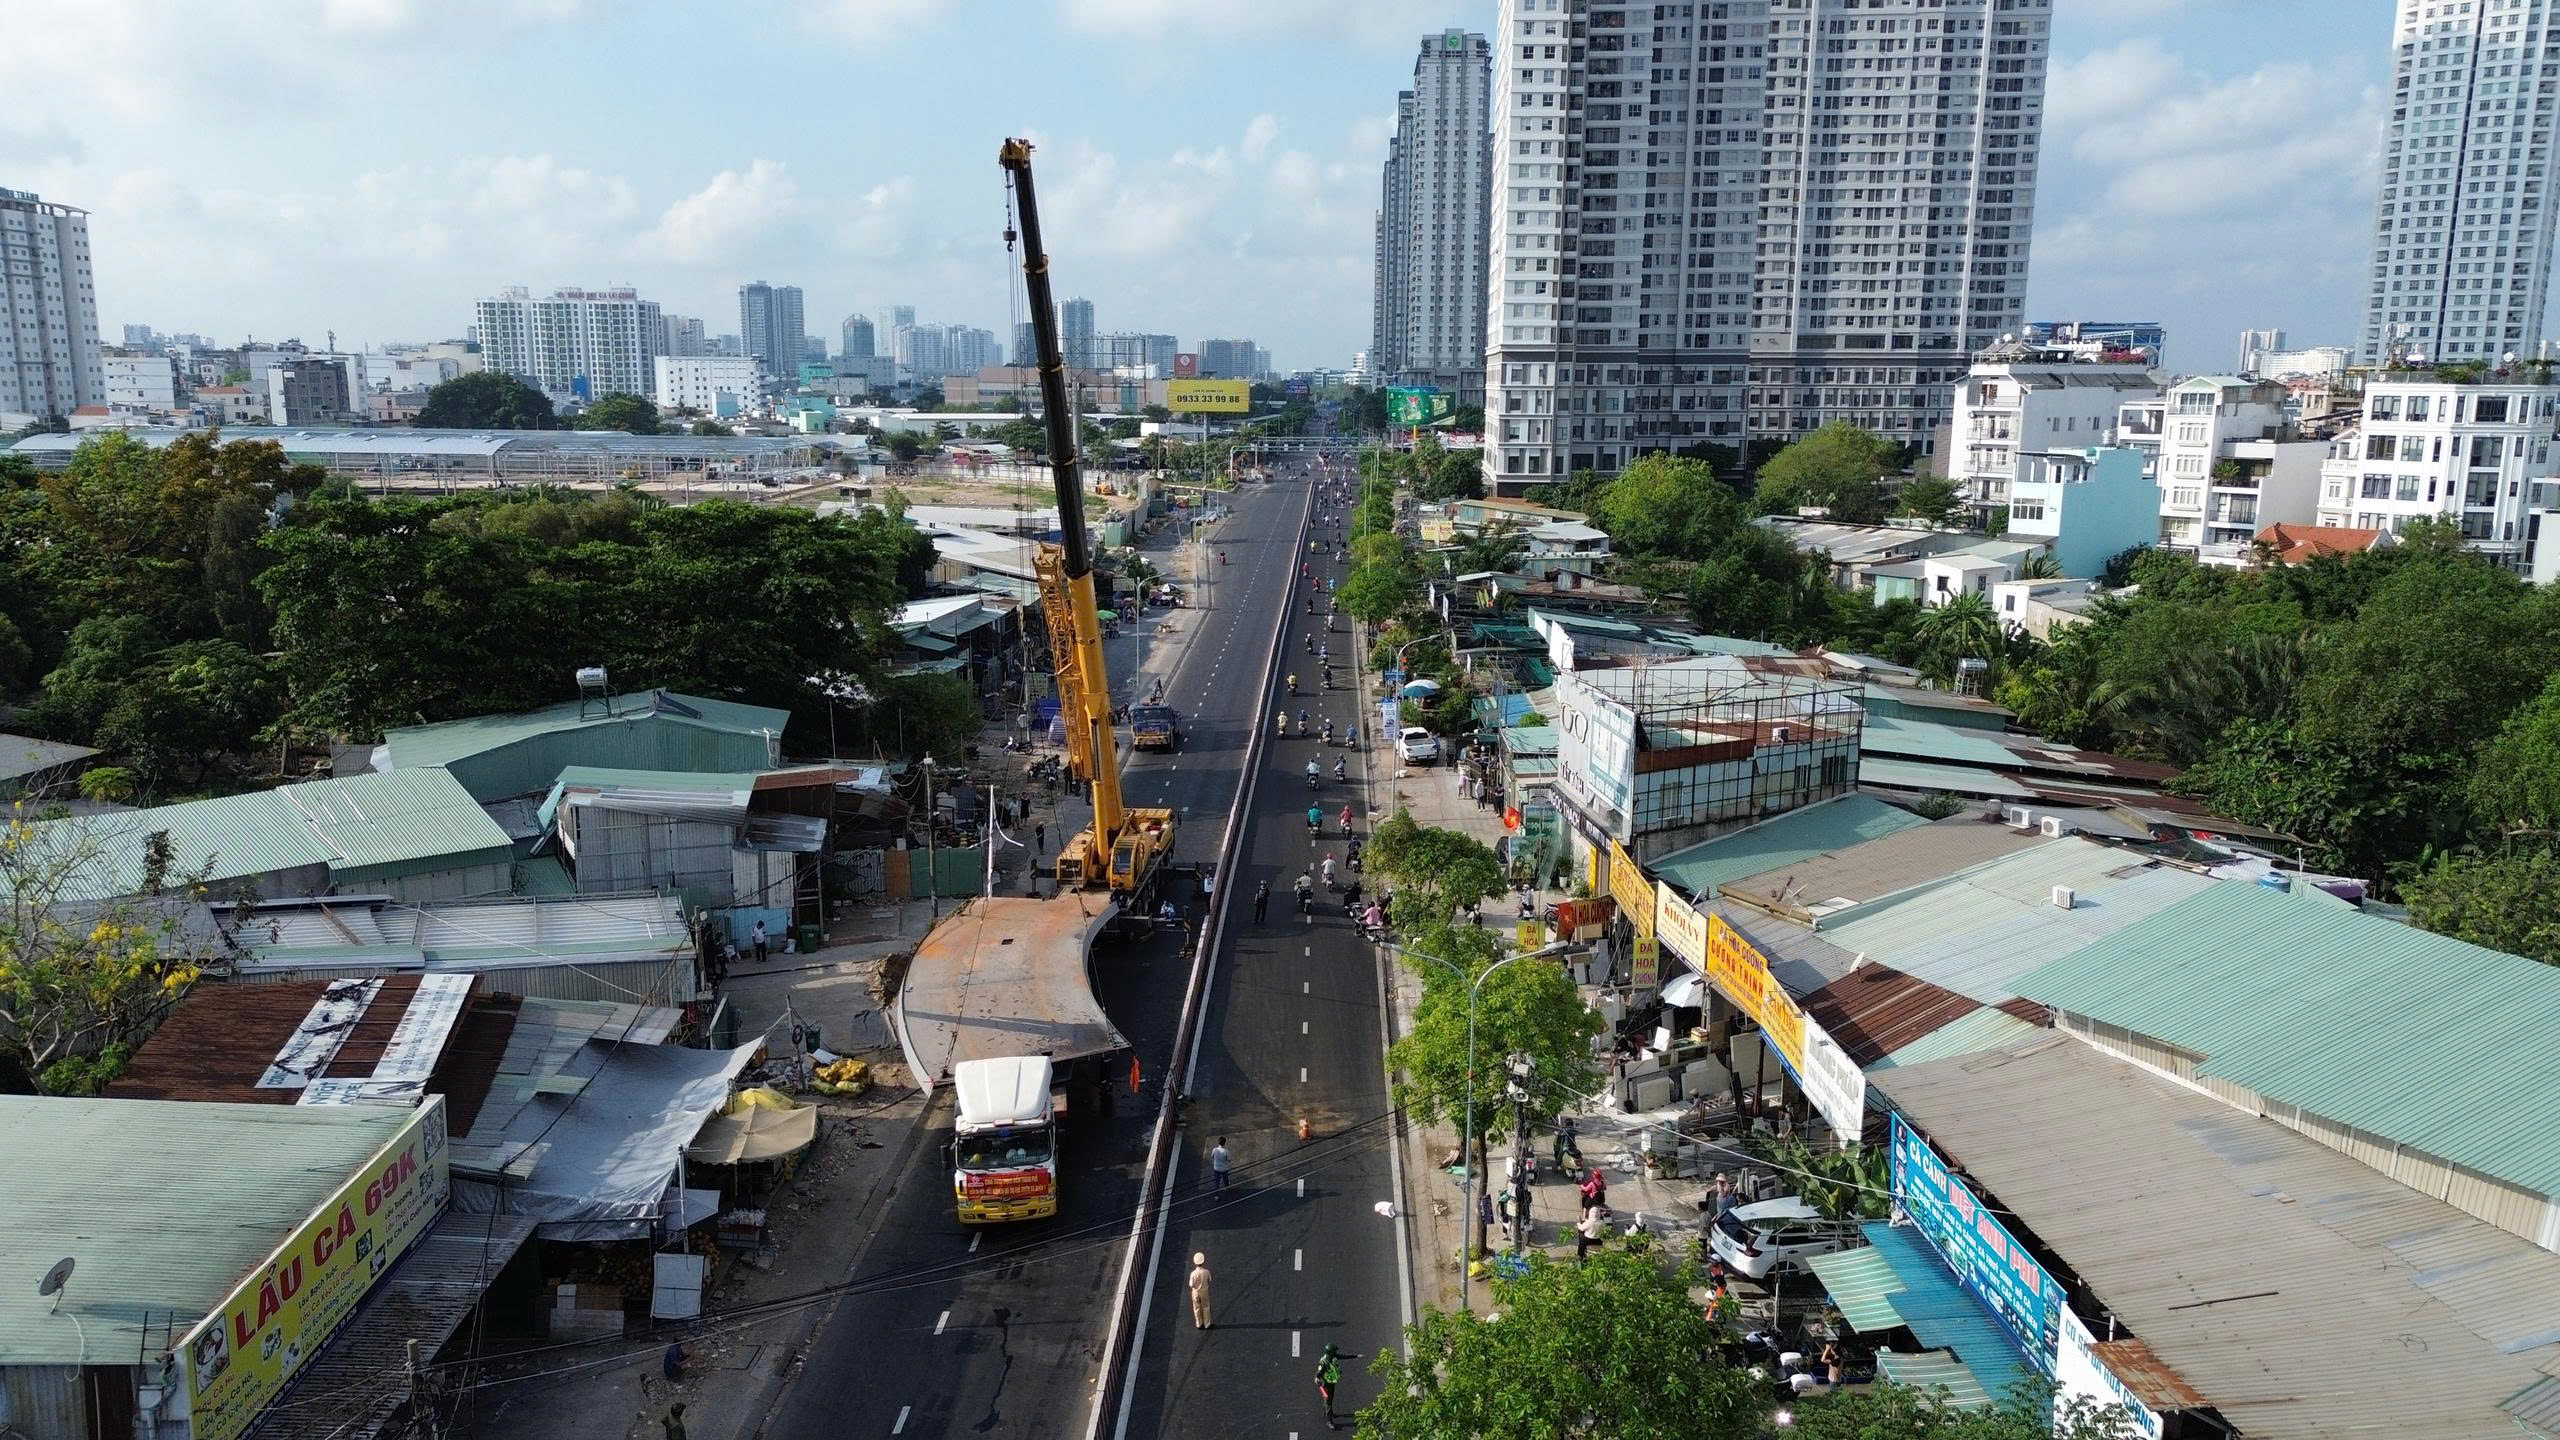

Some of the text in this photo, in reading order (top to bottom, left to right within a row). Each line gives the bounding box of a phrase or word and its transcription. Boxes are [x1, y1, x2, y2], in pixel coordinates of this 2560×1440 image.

[235, 1262, 302, 1350] LẨU
[313, 1200, 357, 1268] CÁ
[365, 1142, 418, 1217] 69K
[1909, 1140, 1922, 1168] CÁ
[1922, 1152, 1947, 1195] CẢNH
[1977, 1211, 2006, 1262] ANH
